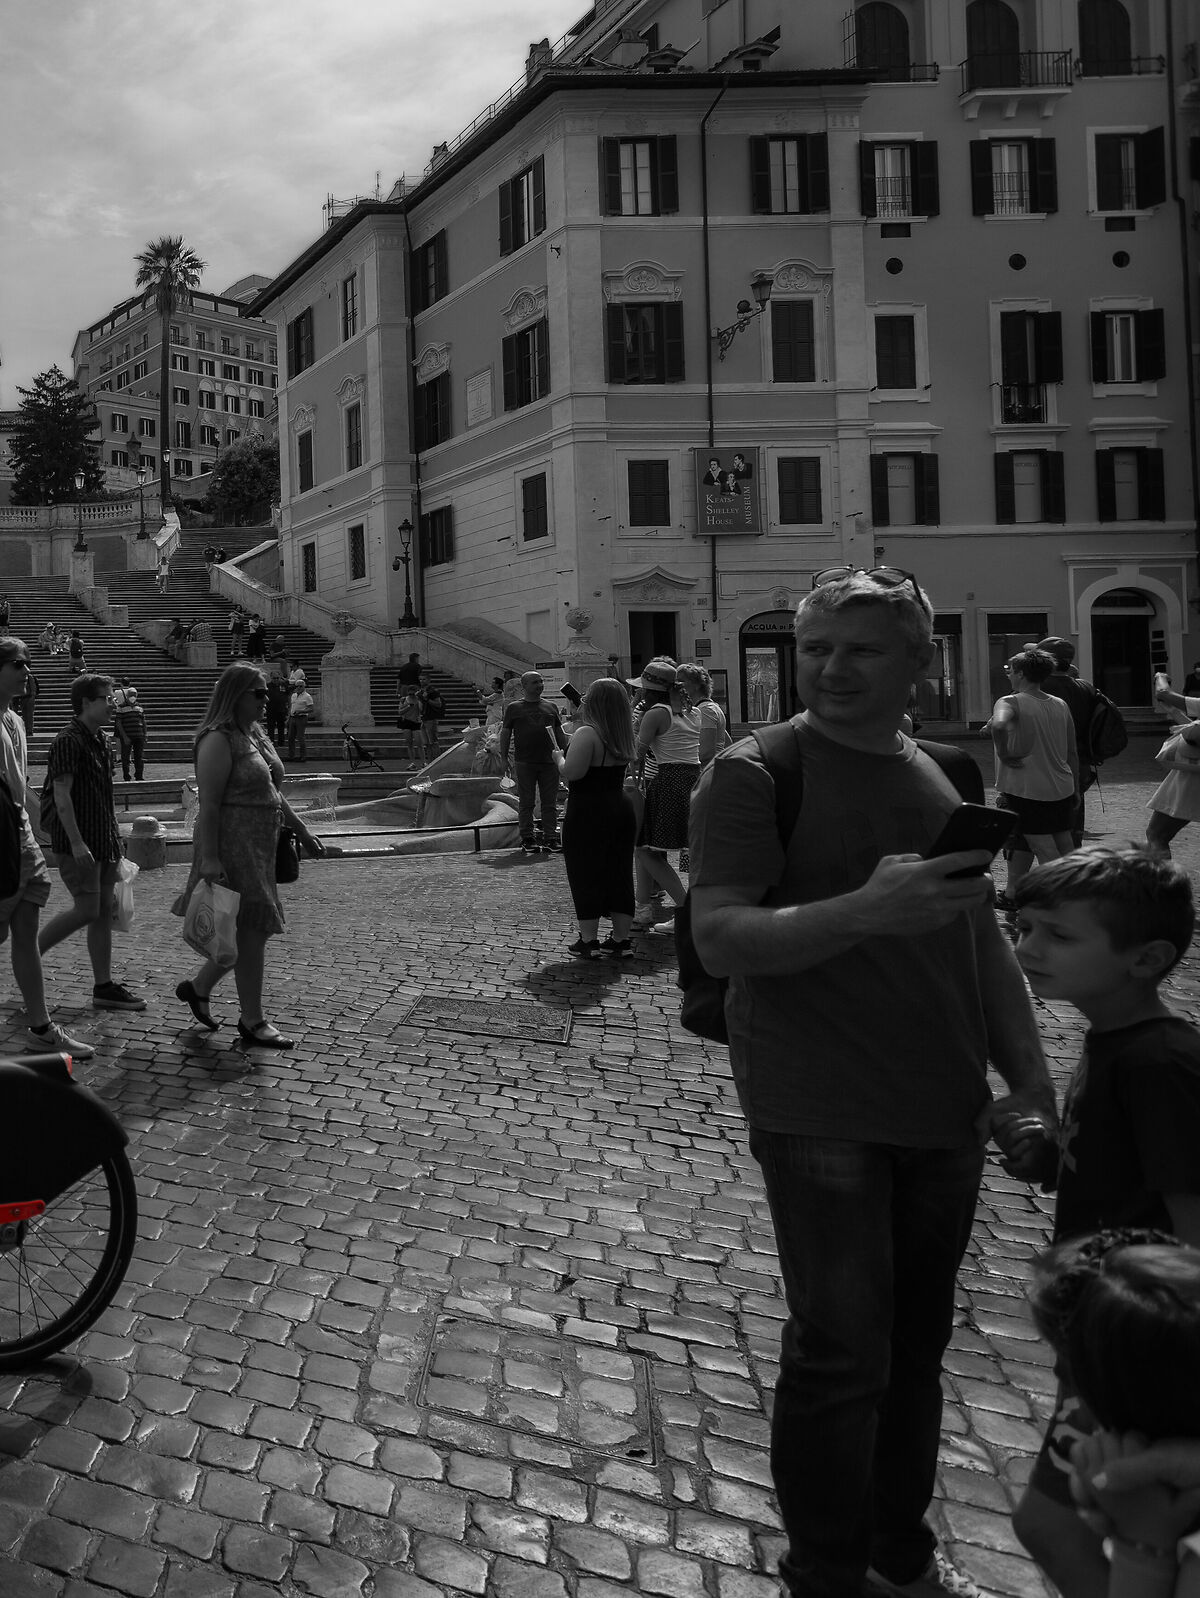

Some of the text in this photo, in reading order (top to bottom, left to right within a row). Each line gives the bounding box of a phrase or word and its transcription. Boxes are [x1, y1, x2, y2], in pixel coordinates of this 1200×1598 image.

[705, 505, 739, 515] SHELLEY
[743, 486, 752, 525] MUSEUM
[706, 515, 734, 525] HOUSE
[747, 623, 777, 631] ACQUA
